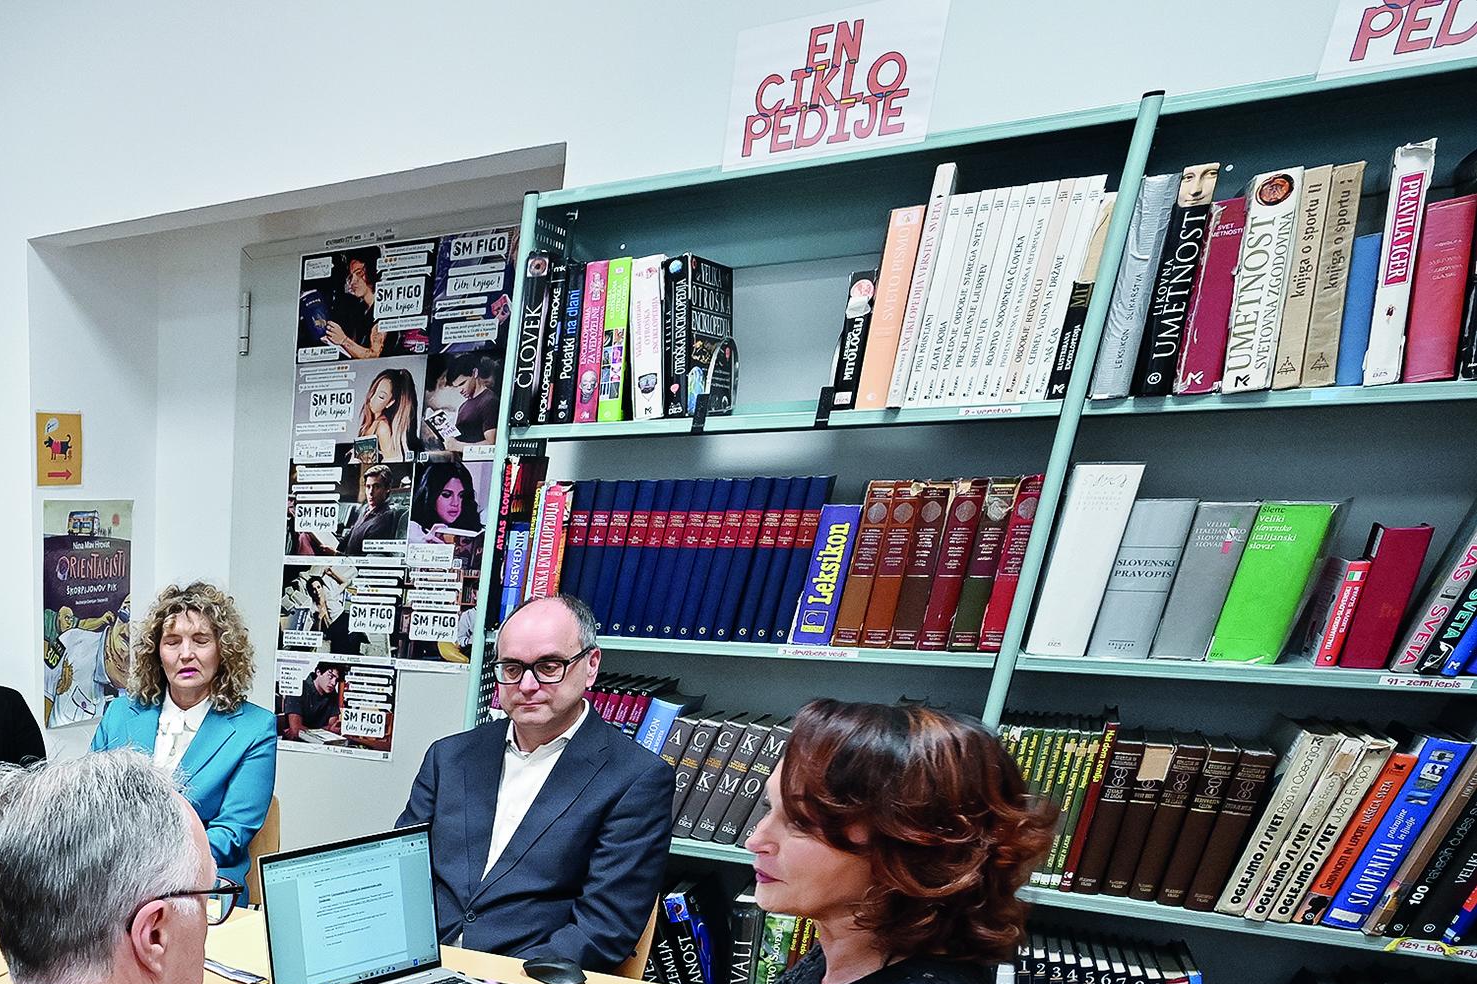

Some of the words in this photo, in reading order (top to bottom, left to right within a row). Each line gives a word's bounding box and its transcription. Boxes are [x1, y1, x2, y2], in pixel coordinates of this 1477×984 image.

[806, 19, 864, 69] EN
[755, 51, 907, 117] CIKLO
[742, 88, 909, 157] PEDIJE
[1393, 178, 1421, 242] PRAVILA
[453, 240, 472, 257] SM
[476, 236, 506, 254] FIGO
[1334, 237, 1343, 245] o
[1290, 260, 1314, 298] knjiga
[1302, 245, 1312, 254] o
[1324, 250, 1346, 290] knjiga
[1388, 245, 1410, 280] IGER
[700, 263, 722, 287] VELIKA
[1153, 212, 1206, 360] UMETNOST
[1153, 258, 1175, 316] LIKOVNA
[376, 287, 395, 302] SM
[396, 284, 422, 300] FIGO
[692, 285, 731, 315] OTROŠKA
[1227, 216, 1276, 373] UMETNOST
[1254, 294, 1279, 369] SVETOVNA
[1267, 211, 1295, 294] ZGODOVINA
[550, 287, 562, 328] OTROKE
[568, 289, 580, 317] dlani
[675, 278, 689, 337] ENCIKLOPEDIJA
[547, 329, 555, 346] ZA
[567, 319, 577, 335] na
[517, 303, 542, 387] ČLOVEK
[674, 338, 686, 375] OTROŠKA
[1115, 328, 1130, 369] LEKSIKON
[560, 337, 574, 379] Podatki
[312, 393, 327, 407] SM
[330, 393, 353, 404] FIGO
[297, 506, 312, 518] SM
[314, 505, 336, 518] FIGO
[496, 520, 507, 550] ATLAS
[1252, 533, 1297, 542] italijanski
[1255, 524, 1293, 532] slovensko
[56, 550, 124, 581] ORIENTACISTI
[509, 530, 525, 587] VSEVEDNIK
[808, 522, 850, 605] Leksikon
[1117, 559, 1176, 567] SLOVENSKI
[1452, 545, 1477, 582] LAS
[351, 606, 369, 618] SM
[371, 608, 393, 620] FIGO
[412, 613, 429, 626] SM
[432, 615, 456, 627] FIGO
[1400, 605, 1449, 666] SVETA
[343, 709, 358, 722] SM
[361, 711, 383, 724] FIGO
[669, 729, 682, 745] A
[693, 731, 709, 748] C
[717, 732, 733, 748] G
[741, 733, 761, 754] K
[763, 736, 786, 756] M
[676, 771, 690, 788] G
[697, 771, 715, 789] K
[719, 774, 741, 793] M
[678, 820, 692, 829] DZS
[700, 822, 715, 832] DZS
[722, 825, 737, 835] DZS
[1388, 808, 1407, 839] pokrajine
[1278, 862, 1316, 915] OGLEJMO
[1318, 823, 1338, 851] SVET
[1350, 765, 1372, 796] Evropa
[1231, 853, 1265, 905] OGLEJMO
[1266, 814, 1285, 842] SVET
[1348, 843, 1403, 906] SLOVENIJA
[1021, 960, 1027, 972] 1
[1036, 963, 1046, 974] 2
[1052, 966, 1061, 978] 3
[1067, 969, 1078, 981] 4
[1085, 971, 1094, 984] 5
